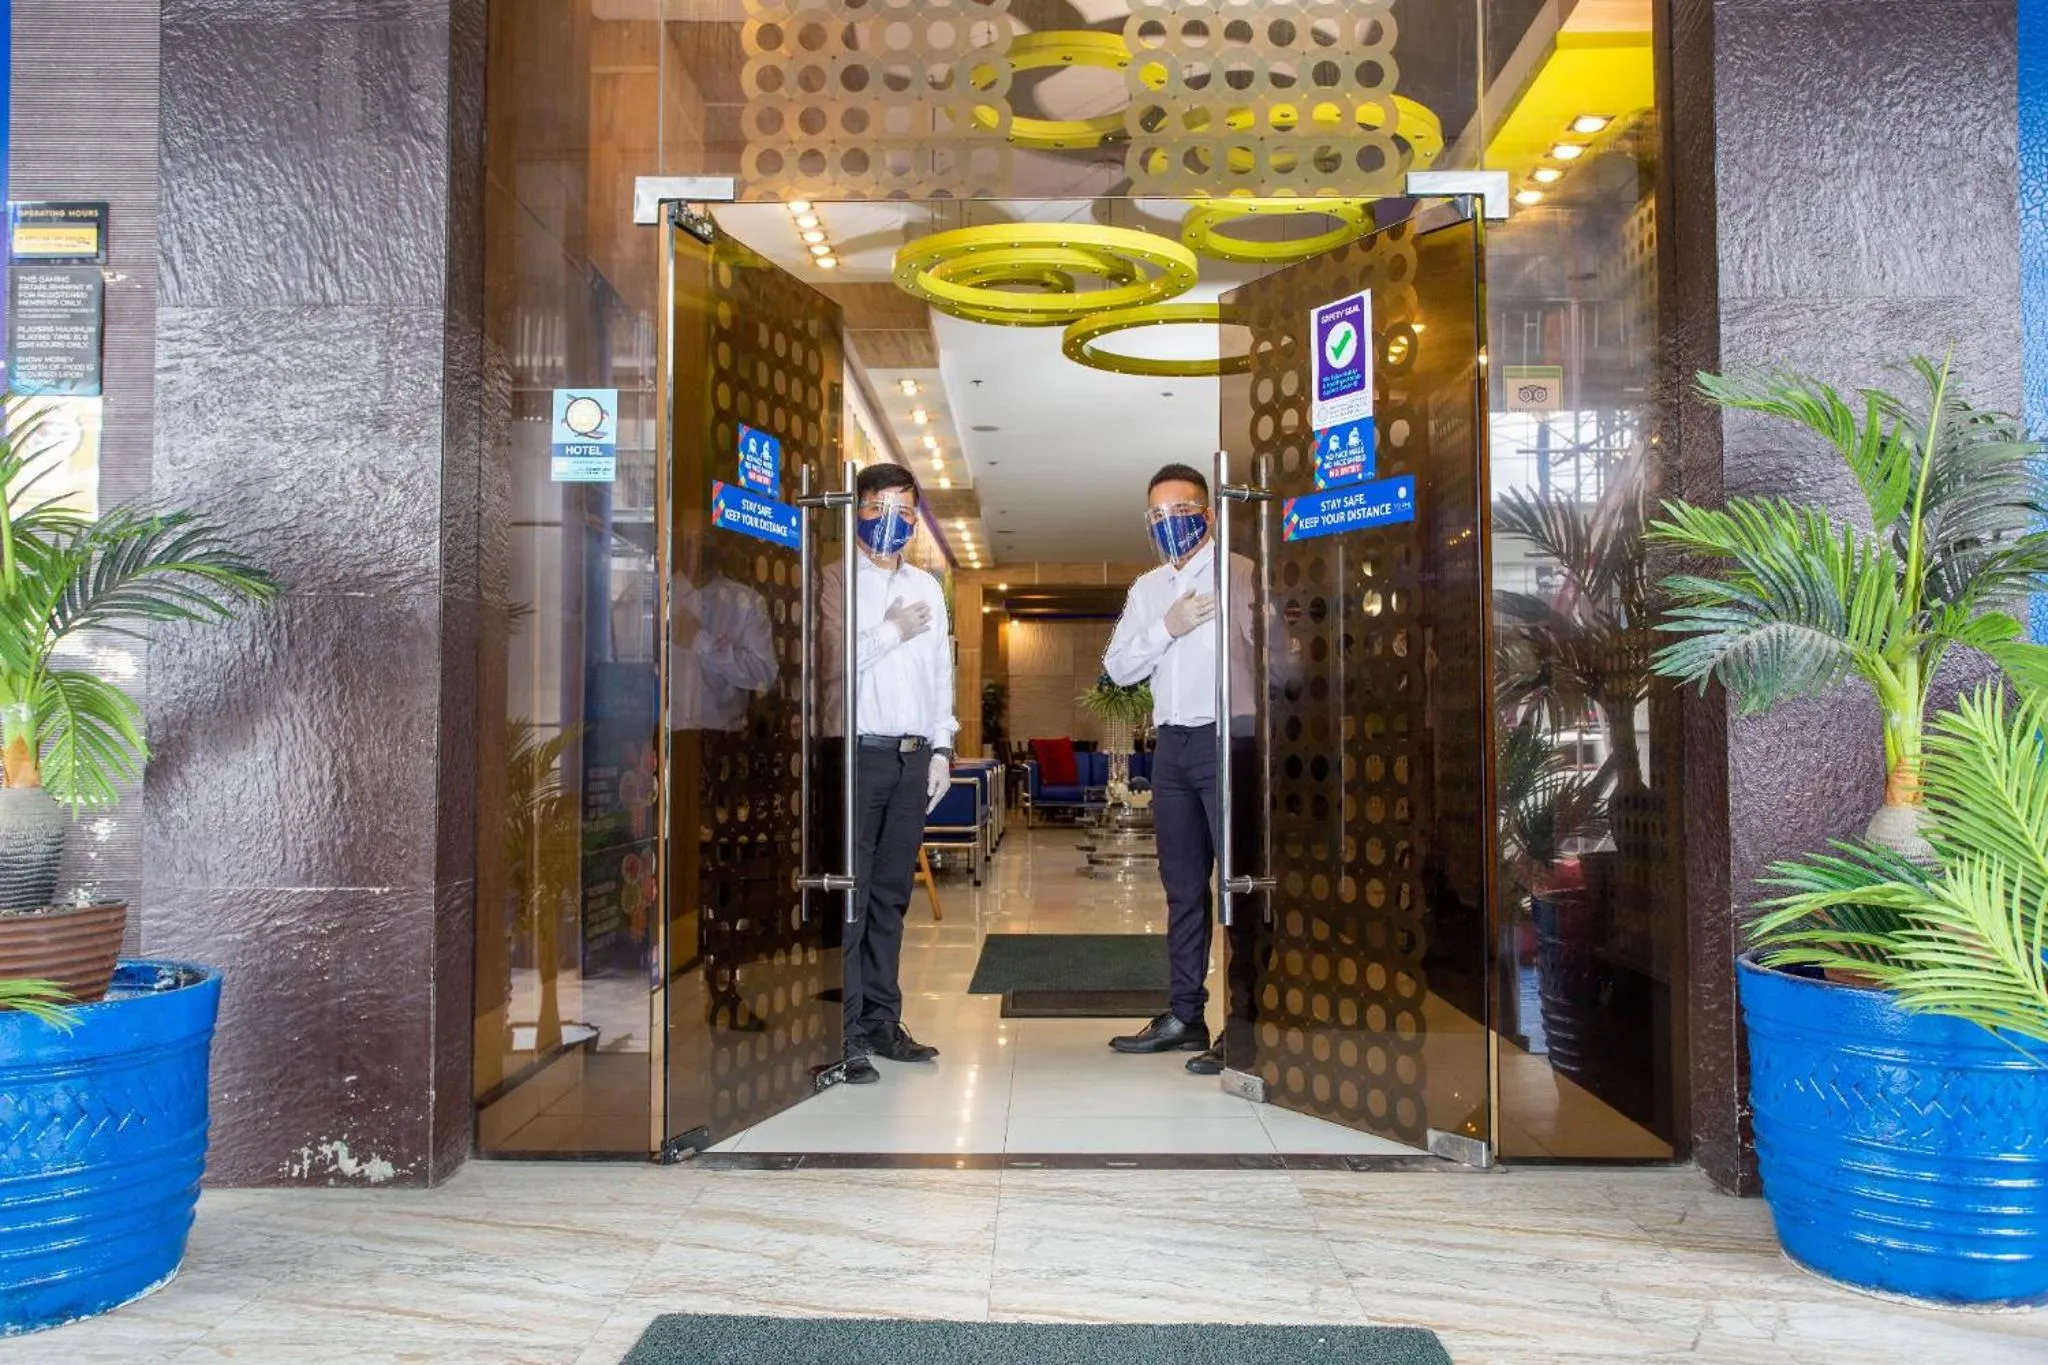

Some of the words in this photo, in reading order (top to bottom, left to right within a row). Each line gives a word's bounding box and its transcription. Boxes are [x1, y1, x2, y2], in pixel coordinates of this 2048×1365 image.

[68, 208, 99, 218] HOURS
[565, 445, 603, 456] HOTEL
[742, 498, 757, 513] STAY
[1321, 498, 1341, 512] STAY
[725, 508, 740, 522] KEEP
[741, 513, 760, 529] YOUR
[760, 519, 788, 537] DISTANCE
[1299, 516, 1320, 530] KEEP
[1321, 512, 1346, 526] YOUR
[1347, 503, 1392, 522] DISTANCE
